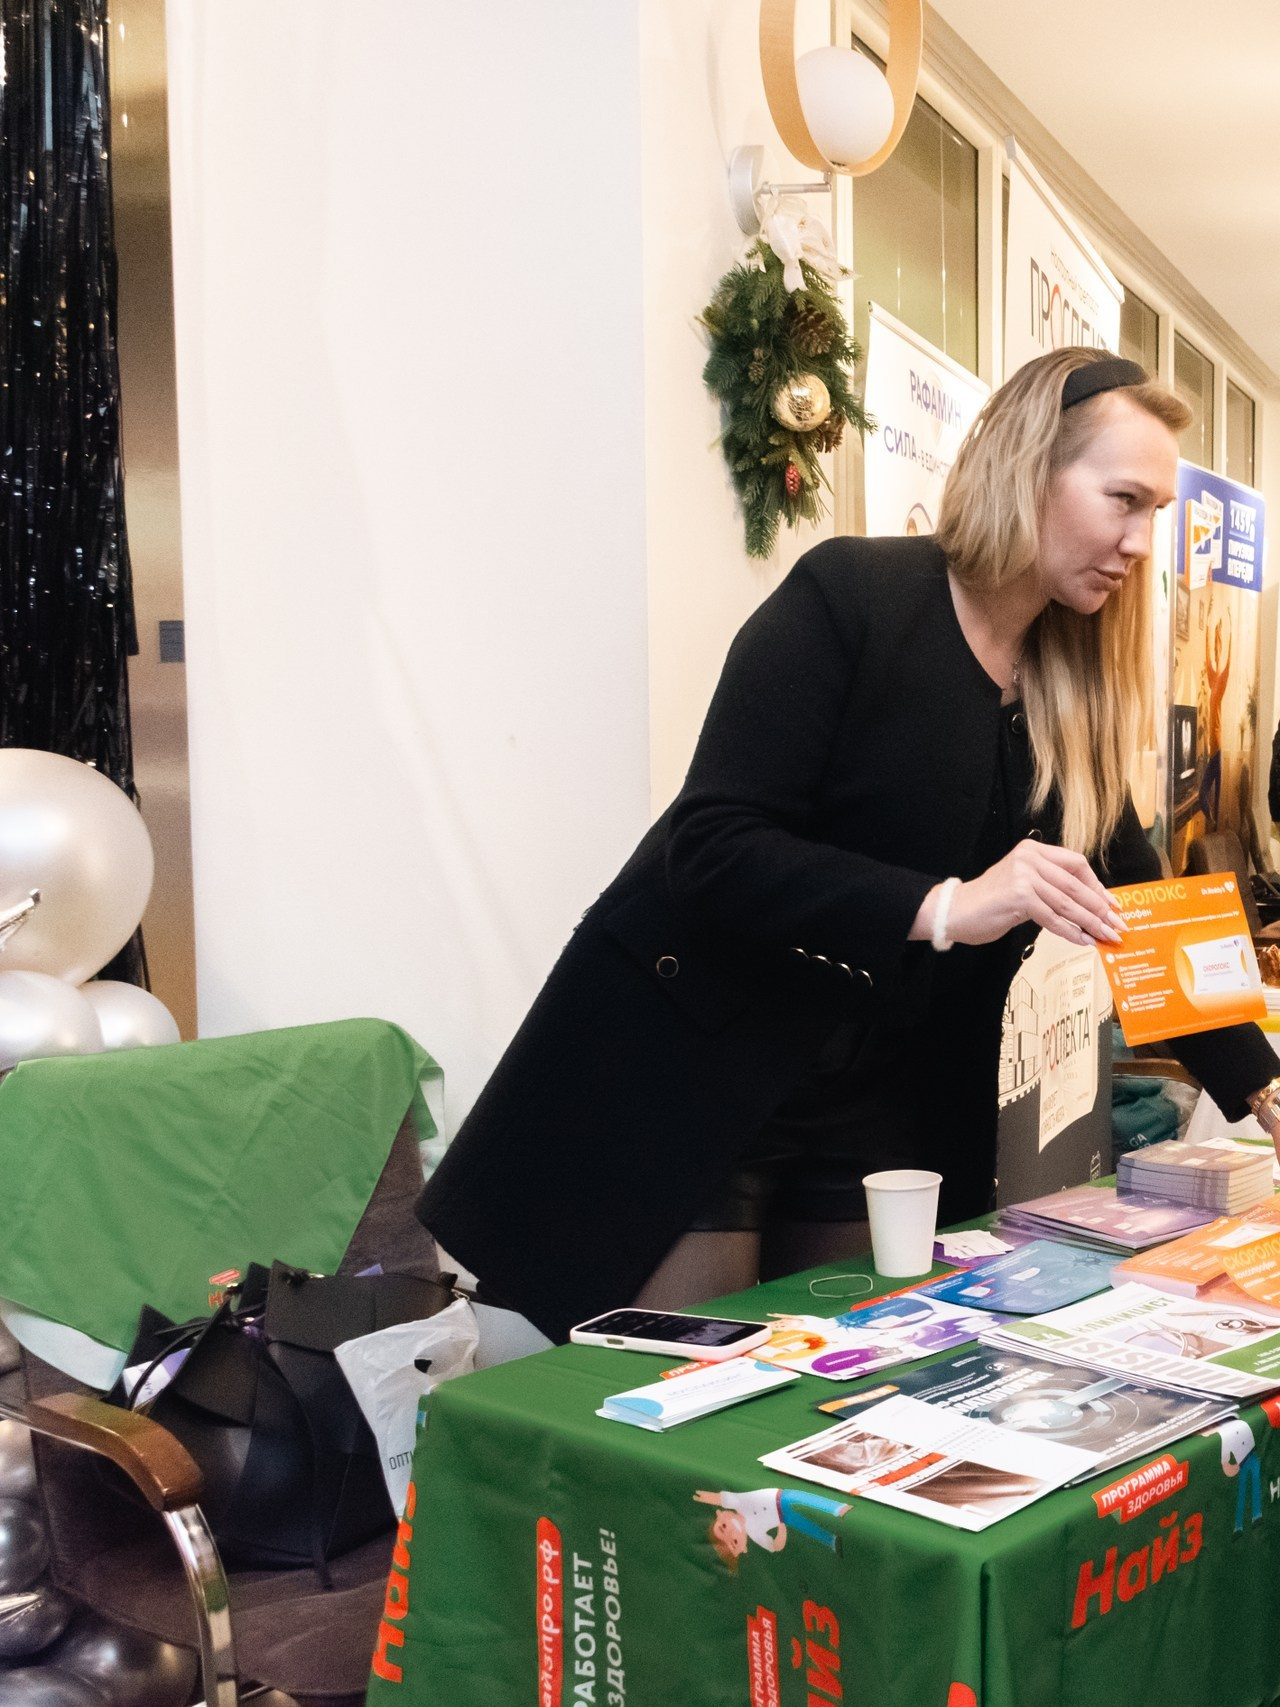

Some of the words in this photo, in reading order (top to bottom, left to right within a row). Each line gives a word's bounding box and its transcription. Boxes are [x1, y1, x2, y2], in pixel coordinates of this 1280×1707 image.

[909, 369, 962, 431] РАФАМИН
[883, 425, 918, 463] СИЛА
[1112, 883, 1187, 909] ОРОЛОКС
[1071, 1296, 1177, 1333] КЛИНИЦИСТ
[944, 1371, 1055, 1415] МАТОЛОГИЯ
[1101, 1460, 1171, 1508] ПРОГРАММА
[1126, 1470, 1184, 1515] ЗДОРОВЬЯ
[1071, 1510, 1203, 1629] Найз
[538, 1538, 560, 1707] айзпро.рф
